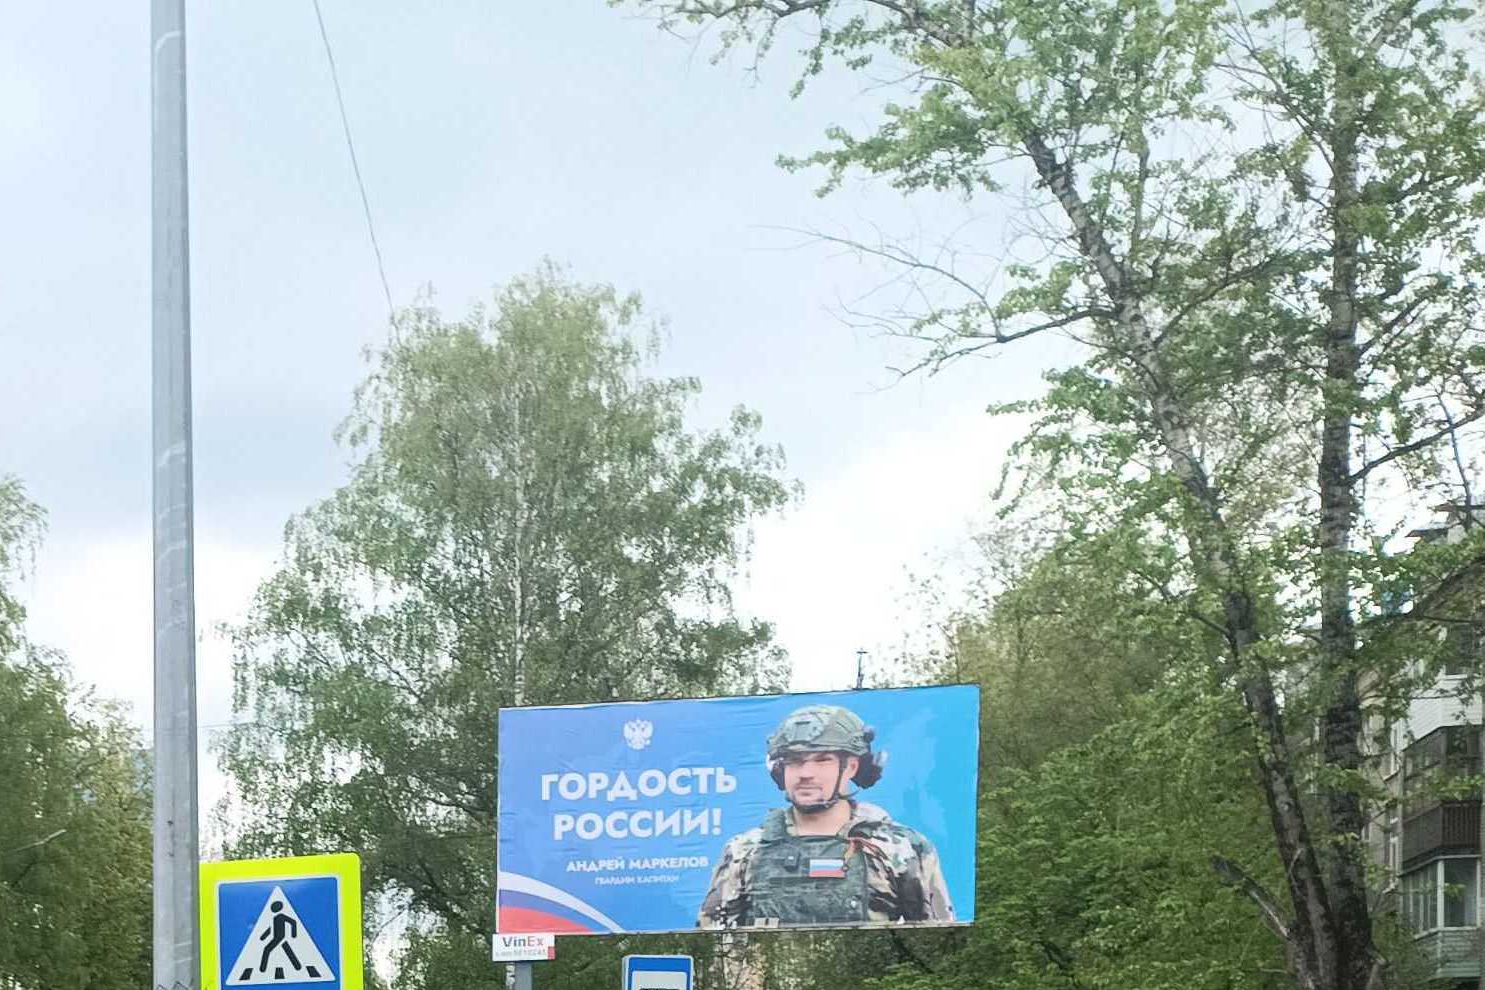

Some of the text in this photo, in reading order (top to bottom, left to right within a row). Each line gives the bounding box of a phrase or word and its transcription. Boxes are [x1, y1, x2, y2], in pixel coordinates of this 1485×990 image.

[541, 767, 738, 801] ГОРДОСТЬ
[553, 808, 723, 841] РОССИИ!
[566, 856, 709, 873] АНДРЕЙ МАРКЕЛОВ
[502, 936, 544, 947] VinEx
